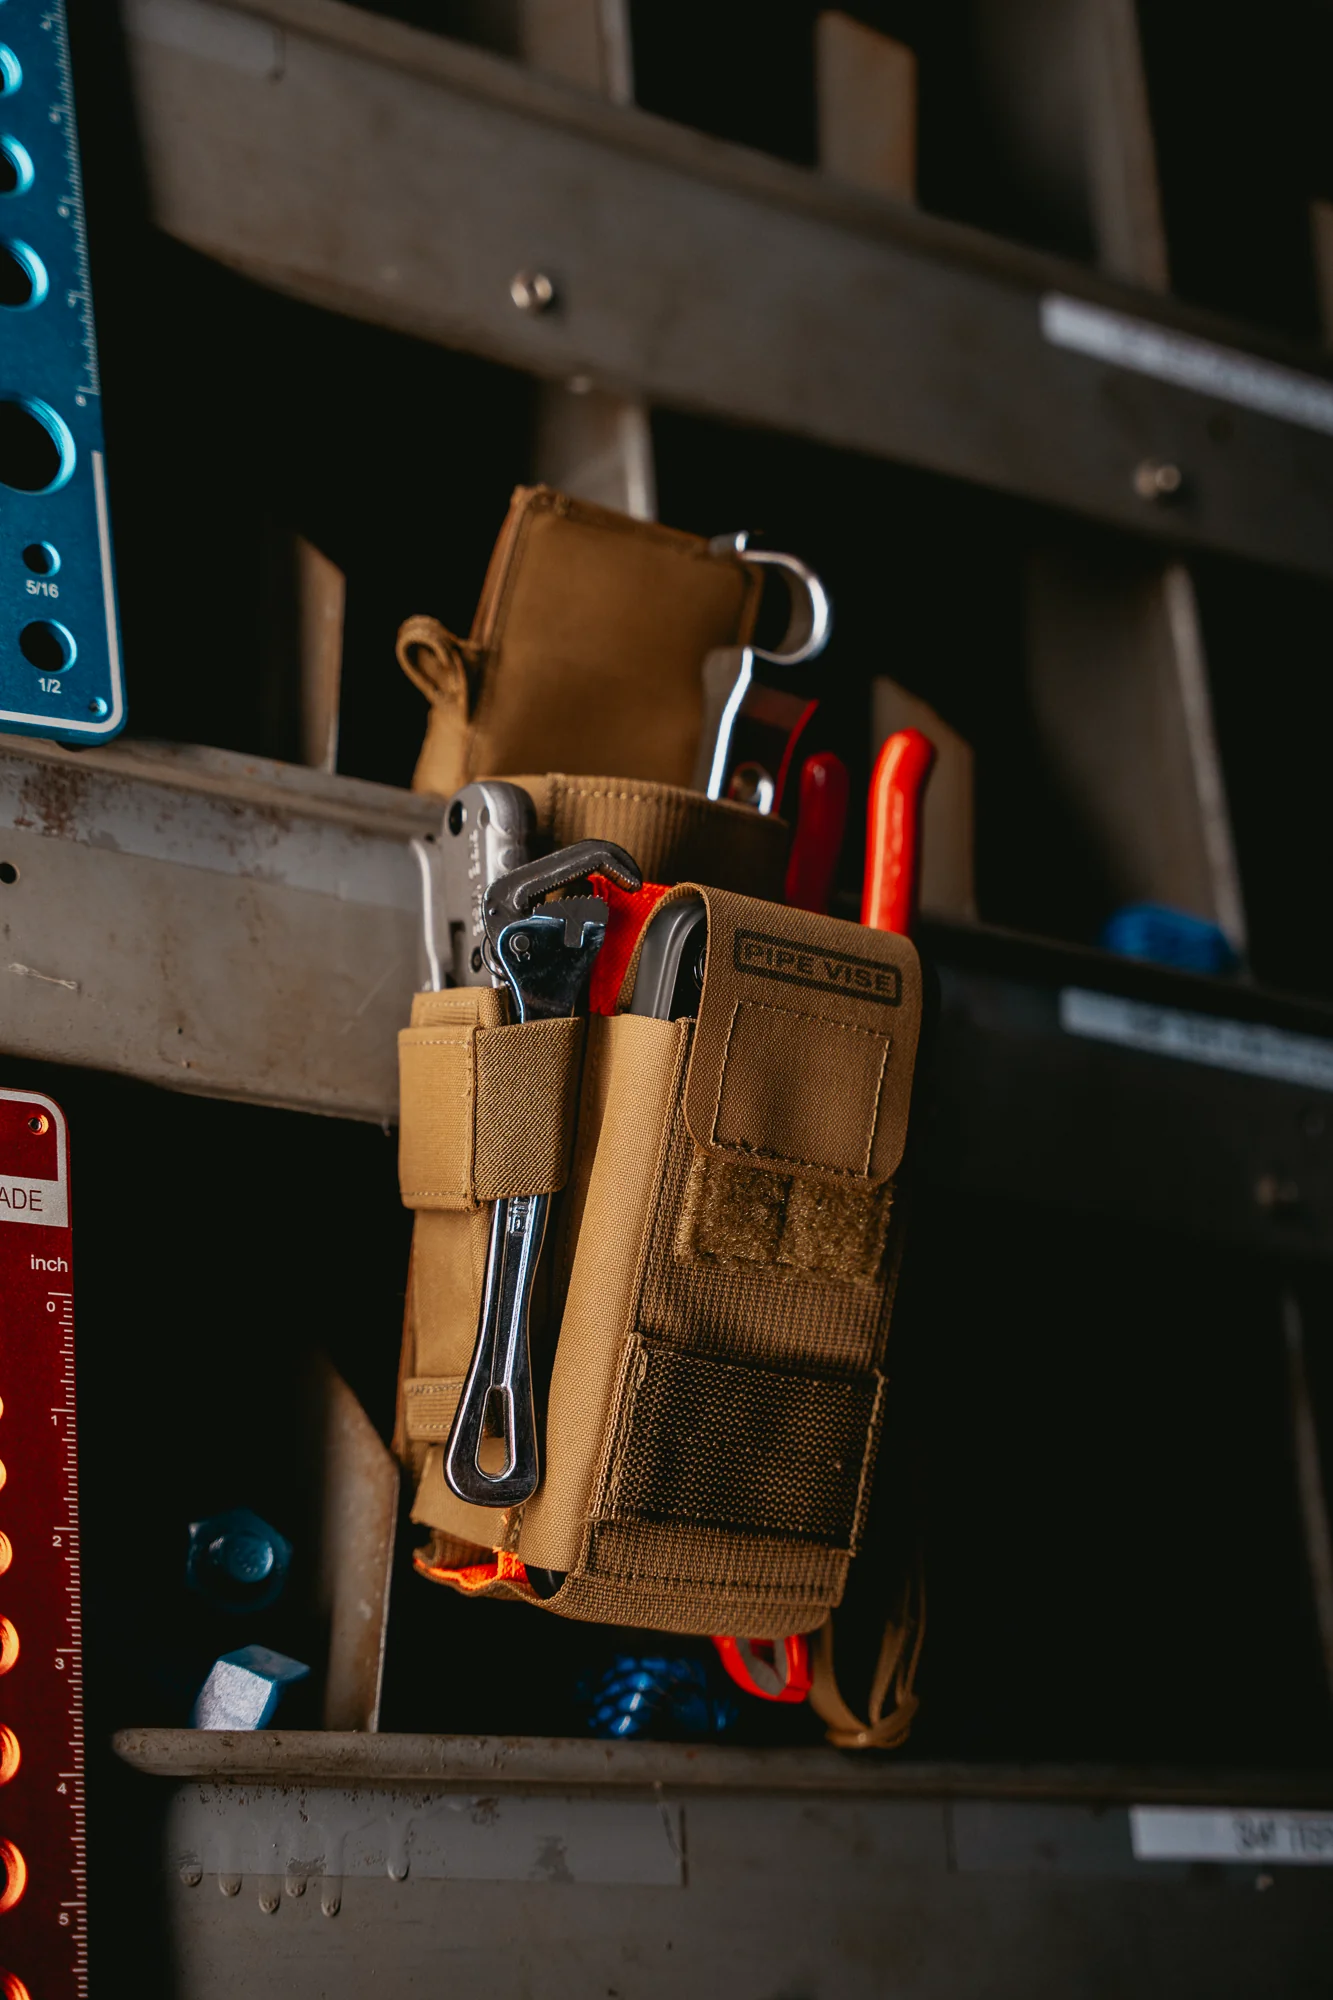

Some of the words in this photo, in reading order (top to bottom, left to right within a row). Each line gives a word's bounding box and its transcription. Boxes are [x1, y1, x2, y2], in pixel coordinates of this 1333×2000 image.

[25, 579, 59, 599] 5/16
[38, 677, 62, 694] 1/2
[742, 942, 815, 975] PIPE
[822, 960, 893, 995] VISE
[30, 1253, 69, 1273] inch
[46, 1301, 56, 1313] 0
[50, 1414, 58, 1426] 1
[52, 1534, 62, 1548] 2
[54, 1657, 65, 1670] 3
[56, 1782, 67, 1795] 4
[58, 1912, 69, 1926] 5
